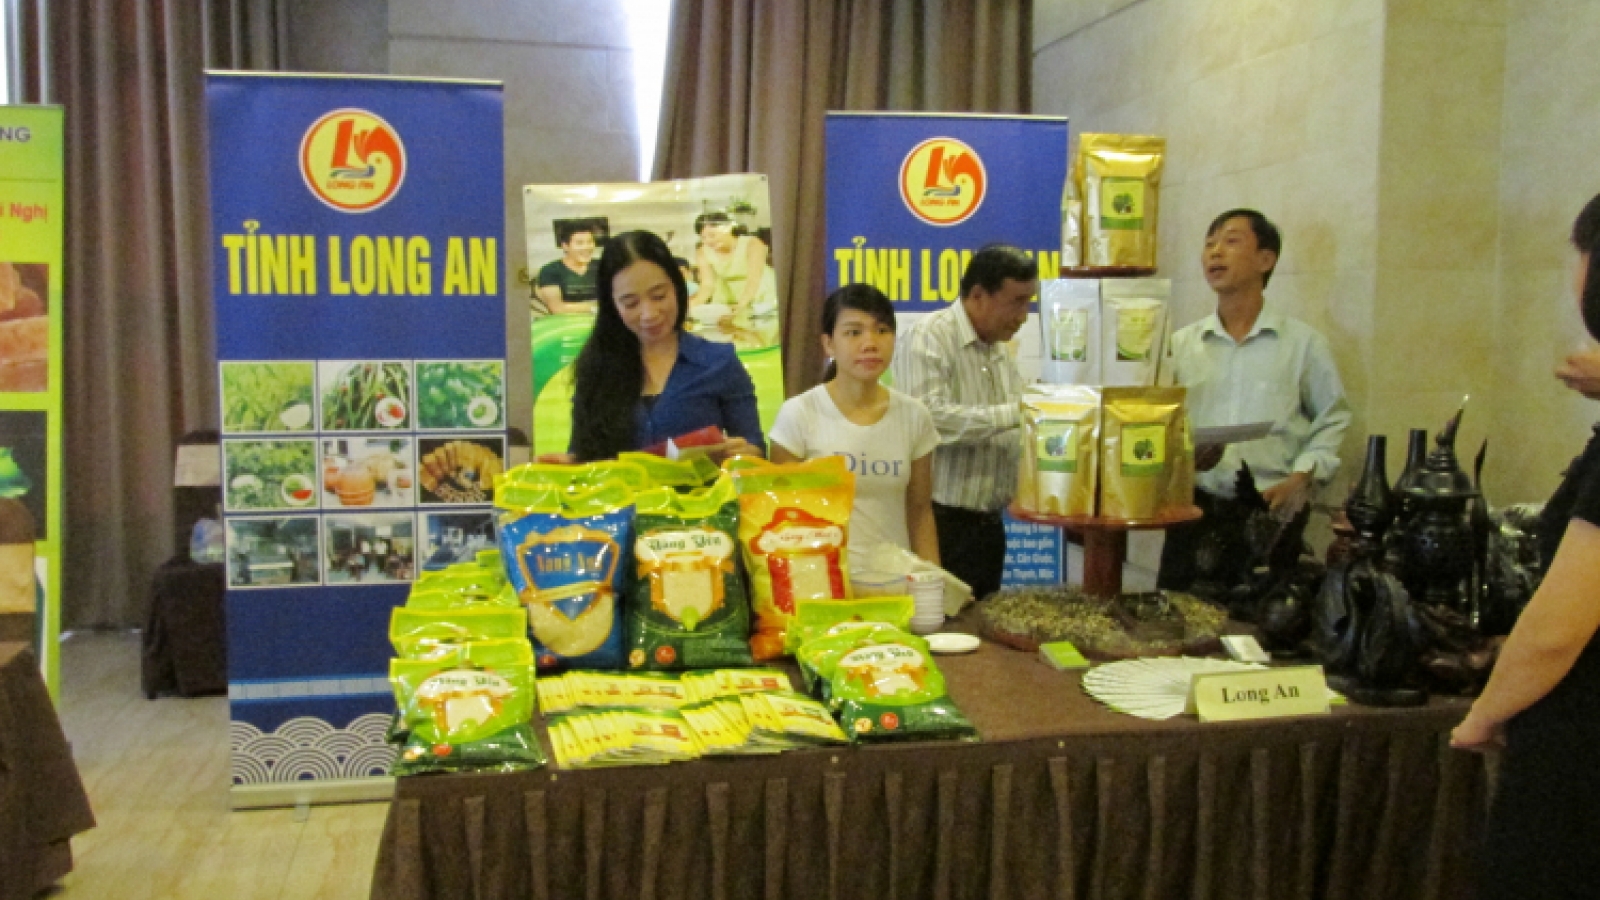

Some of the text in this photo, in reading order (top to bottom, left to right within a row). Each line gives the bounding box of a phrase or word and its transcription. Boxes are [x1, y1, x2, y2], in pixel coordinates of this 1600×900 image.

[221, 219, 499, 297] TỈNH LONG AN
[833, 236, 912, 303] TỈNH
[1221, 683, 1300, 704] Long An
